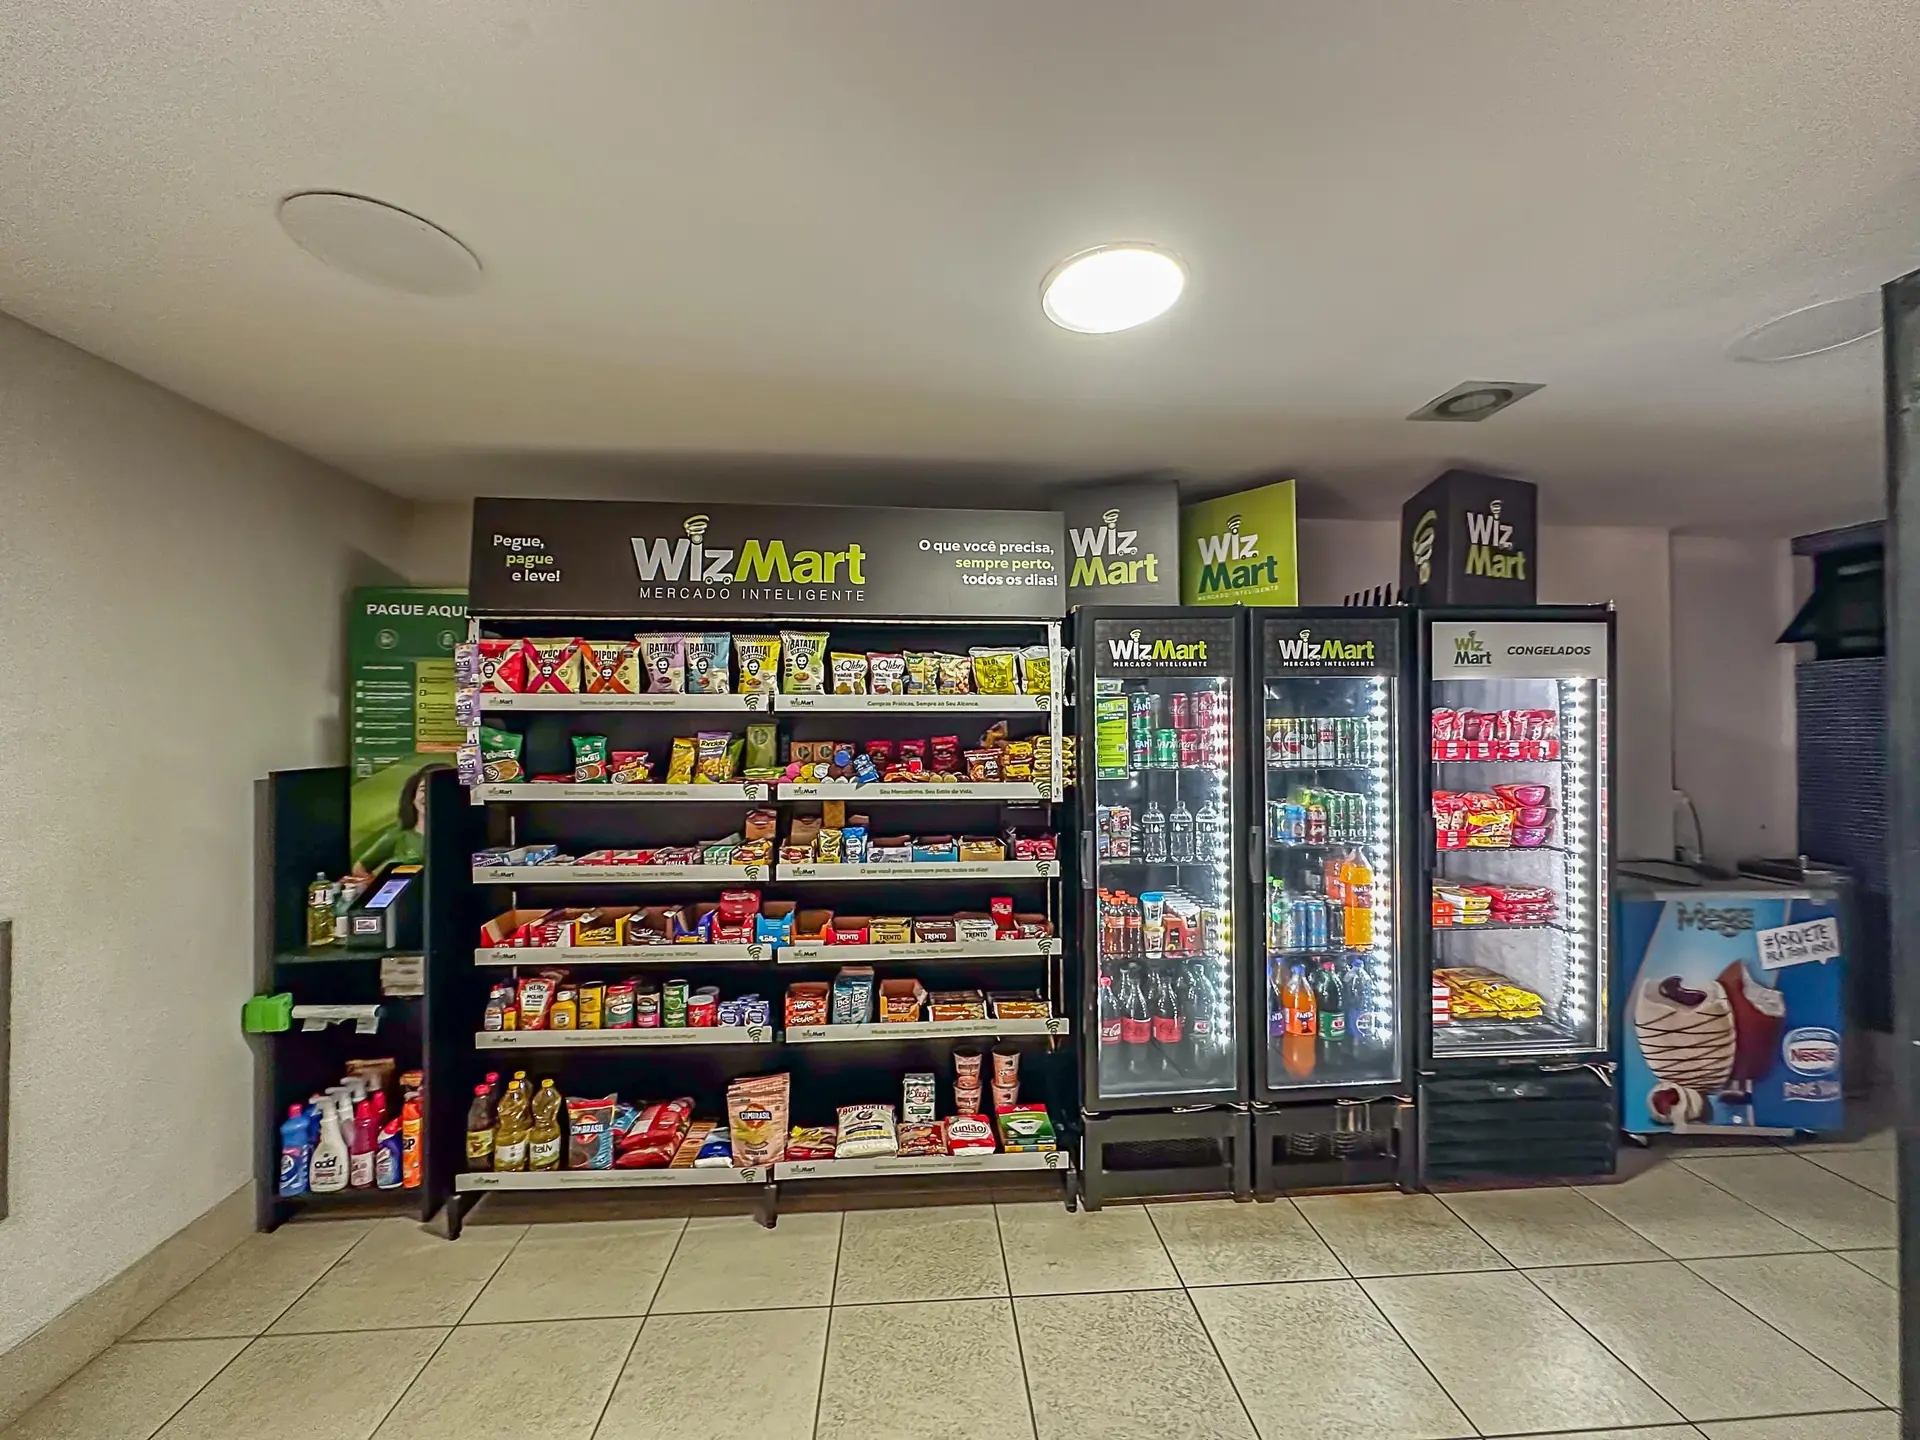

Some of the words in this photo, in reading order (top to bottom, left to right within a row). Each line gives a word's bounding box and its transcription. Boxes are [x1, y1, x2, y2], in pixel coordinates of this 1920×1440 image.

[1467, 511, 1513, 549] Wiz
[493, 534, 545, 550] Pegue,
[1069, 522, 1138, 557] Wiz
[1198, 526, 1260, 565] Wiz
[919, 540, 931, 551] O
[933, 541, 961, 554] que
[963, 541, 996, 552] você
[1000, 541, 1054, 556] precisa,
[506, 554, 554, 568] pague
[630, 532, 866, 585] WizMart
[955, 558, 1009, 571] sempre
[1012, 558, 1055, 572] perto,
[1465, 544, 1526, 580] Mart
[512, 571, 521, 582] e
[524, 569, 560, 582] leve!
[1070, 553, 1159, 587] Mart
[1198, 555, 1279, 593] Mart
[962, 573, 1003, 586] todos
[1006, 575, 1022, 586] os
[1025, 574, 1058, 586] dias!
[640, 587, 731, 599] MERCADO
[742, 588, 865, 601] INTELIGENTE
[366, 604, 424, 616] PAGUE
[649, 642, 676, 654] BATATA
[689, 642, 716, 655] BATATA
[790, 639, 816, 651] BATATA
[1108, 637, 1208, 661] WizMart
[1278, 637, 1375, 661] WizMart
[1454, 634, 1484, 652] Wiz
[741, 645, 768, 657] BATATA
[1507, 646, 1591, 655] CONGELADOS
[1454, 651, 1492, 664] Mart
[1133, 702, 1151, 711] FANT
[1134, 739, 1152, 748] FANT
[836, 933, 858, 941] TRENTO
[878, 933, 902, 941] TRENTO
[924, 932, 947, 940] TRENTO
[965, 931, 987, 939] TRENTO
[528, 984, 546, 992] HEINZ
[954, 1122, 983, 1132] união
